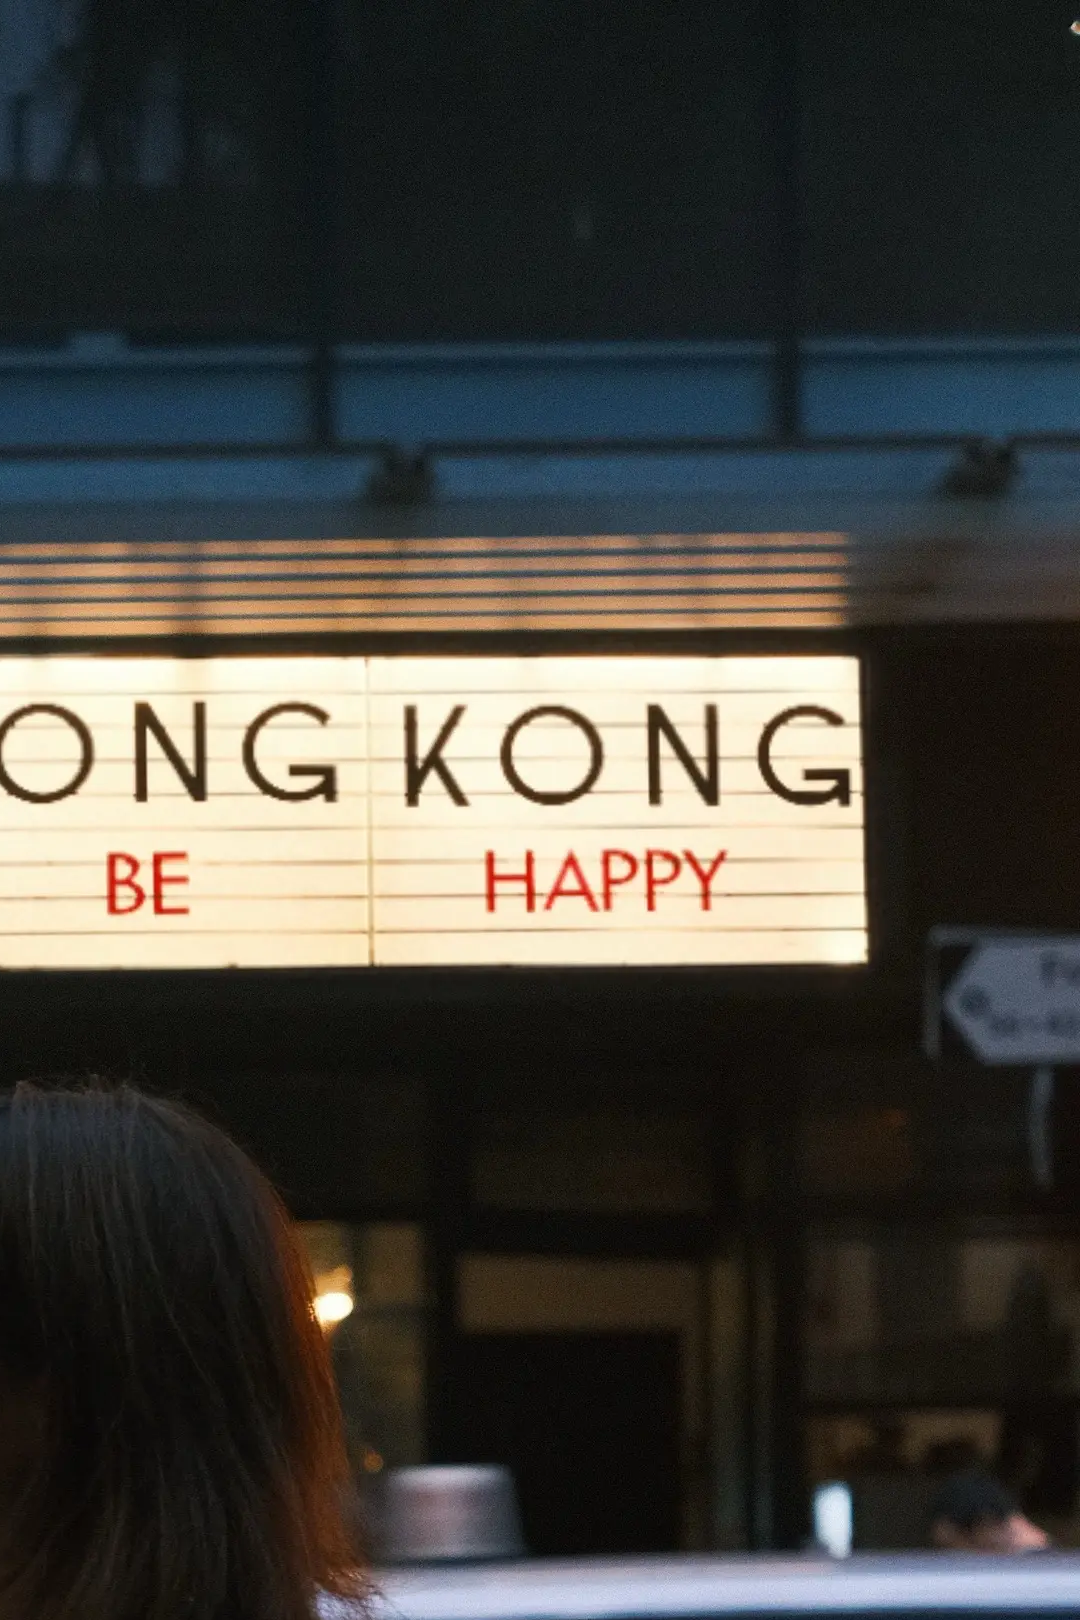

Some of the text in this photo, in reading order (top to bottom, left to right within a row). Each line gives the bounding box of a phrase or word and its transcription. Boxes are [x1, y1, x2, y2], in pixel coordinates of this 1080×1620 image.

[404, 705, 852, 806] KONG
[105, 848, 728, 916] BE HAPPY
